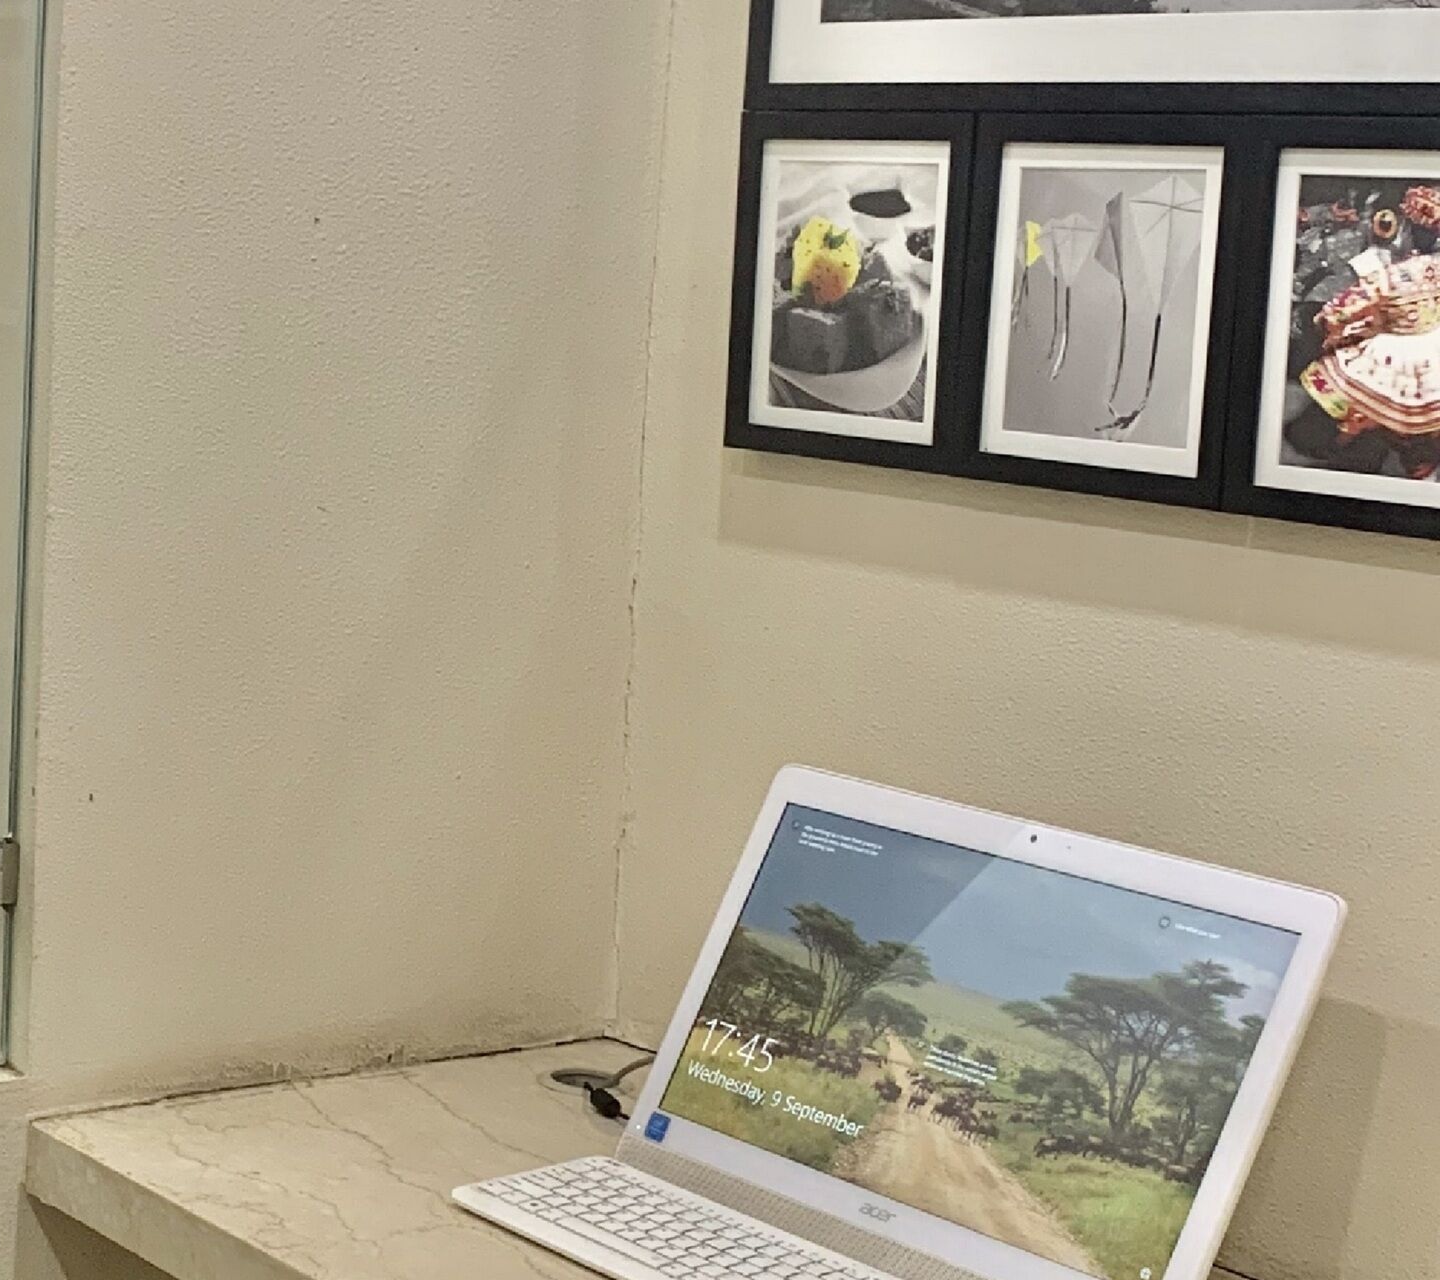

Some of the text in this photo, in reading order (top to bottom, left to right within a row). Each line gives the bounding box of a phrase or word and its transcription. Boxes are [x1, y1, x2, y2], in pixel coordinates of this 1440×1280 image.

[701, 1018, 781, 1073] 17:45
[687, 1059, 865, 1138] Wednesday, 9 September
[858, 1202, 897, 1223] acer
